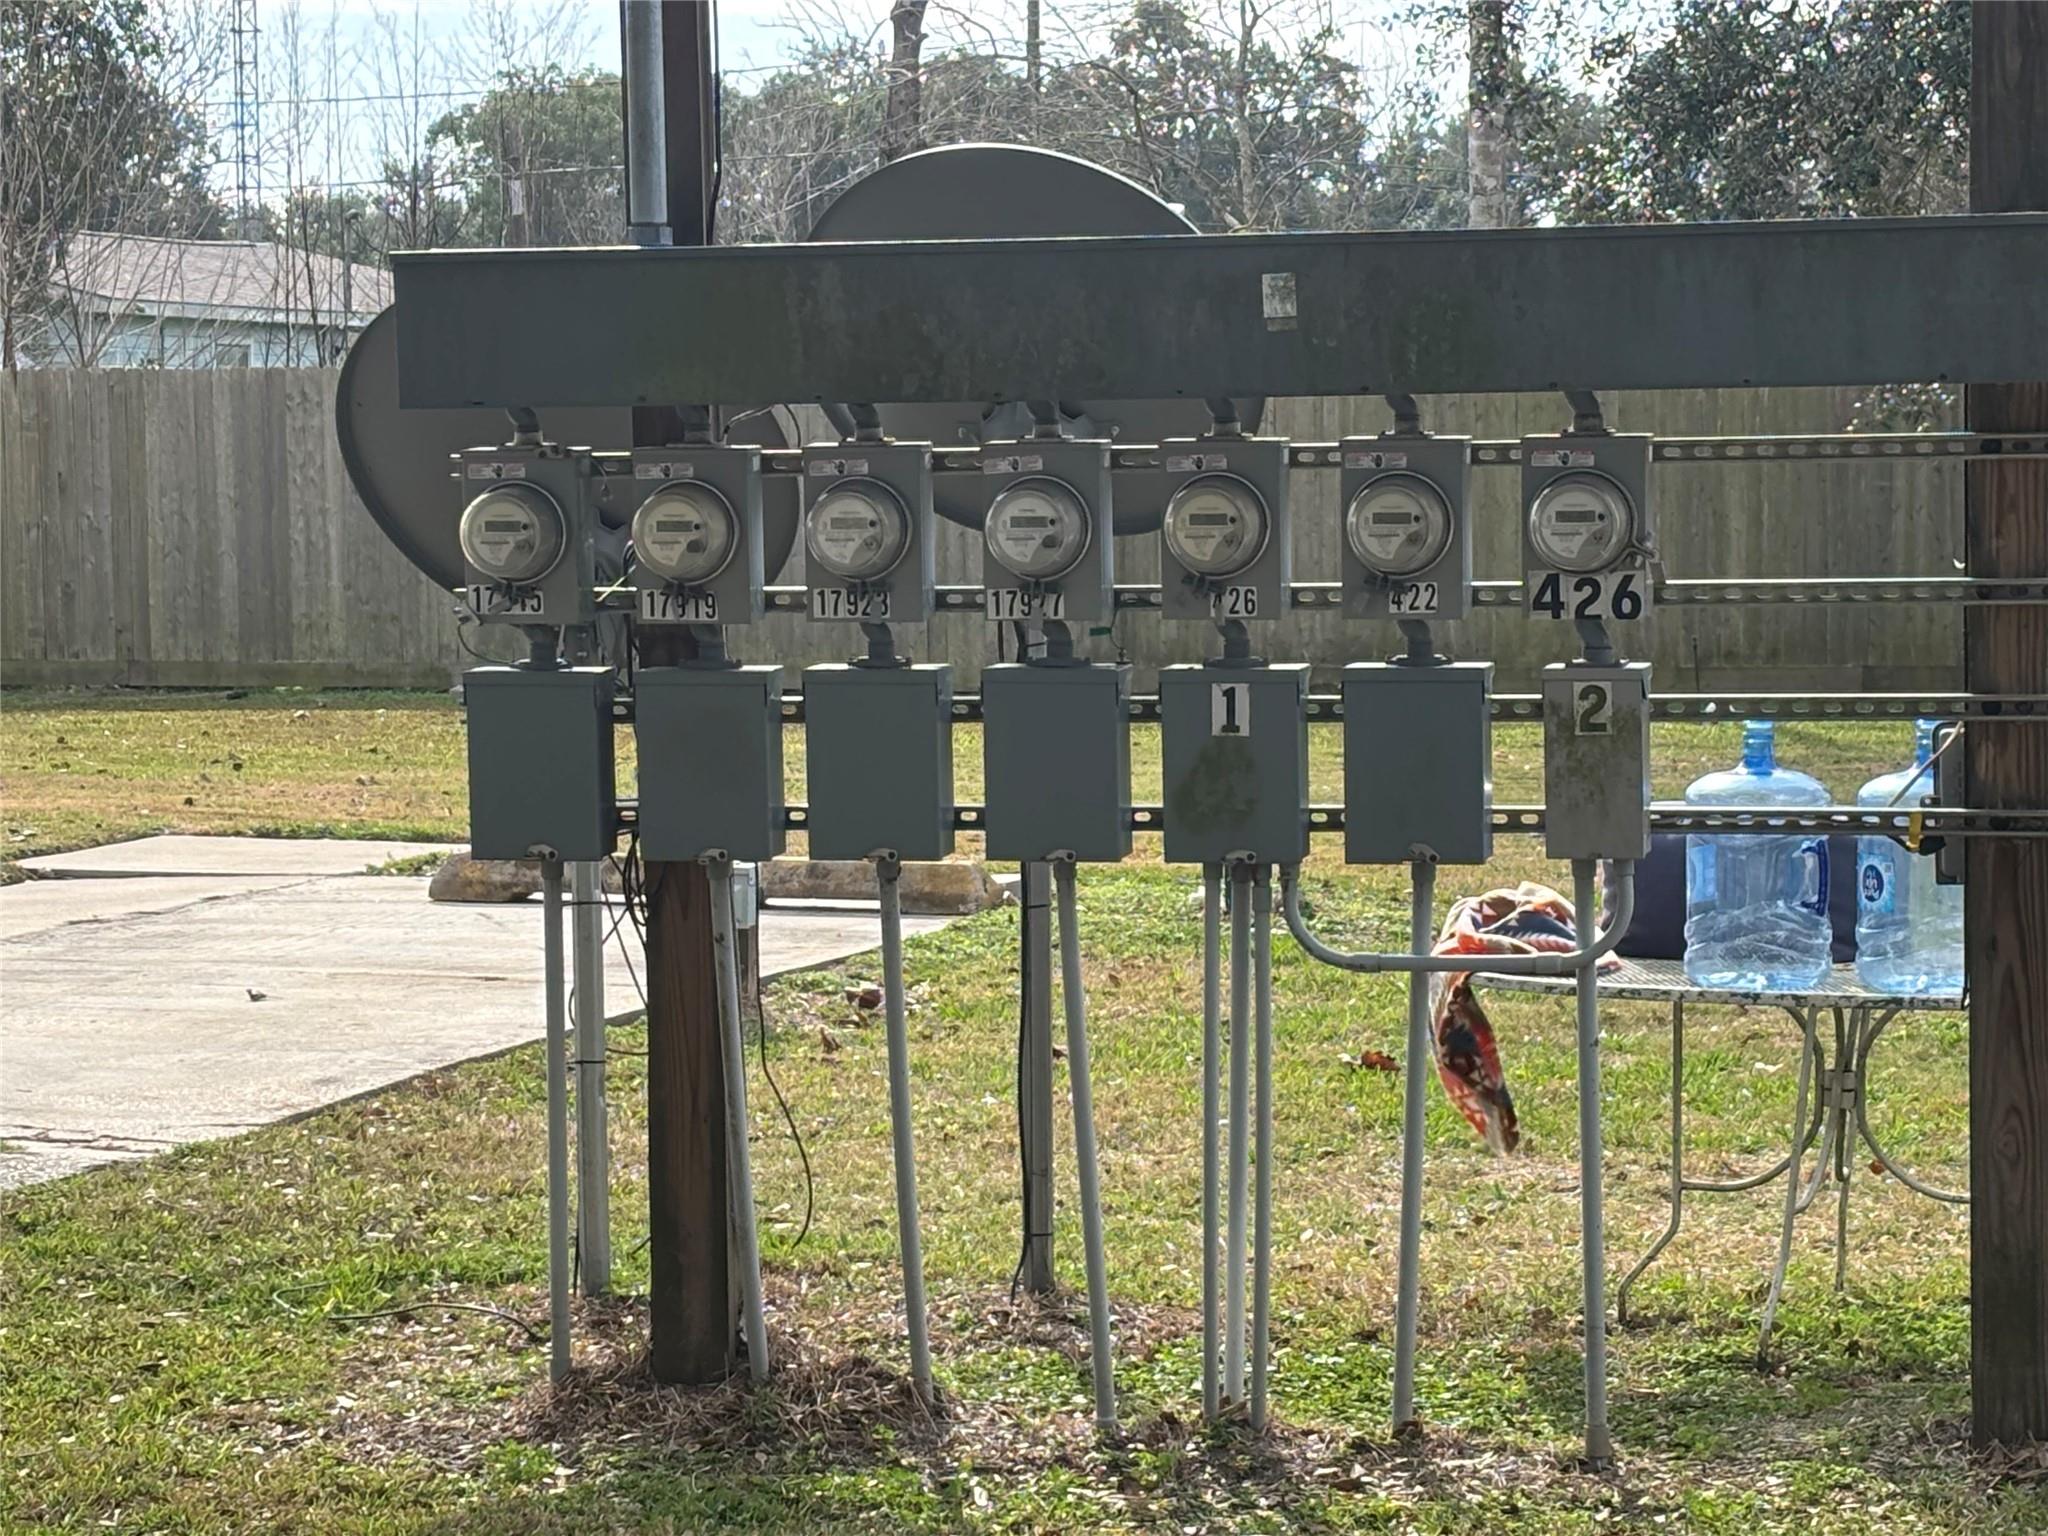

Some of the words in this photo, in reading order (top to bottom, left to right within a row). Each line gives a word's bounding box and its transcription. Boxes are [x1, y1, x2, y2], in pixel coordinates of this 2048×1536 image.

[472, 586, 542, 612] 1715
[646, 591, 716, 619] 17919
[1391, 583, 1437, 611] 422
[1532, 573, 1642, 620] 426
[1221, 685, 1240, 733] 1
[1579, 684, 1607, 732] 2
